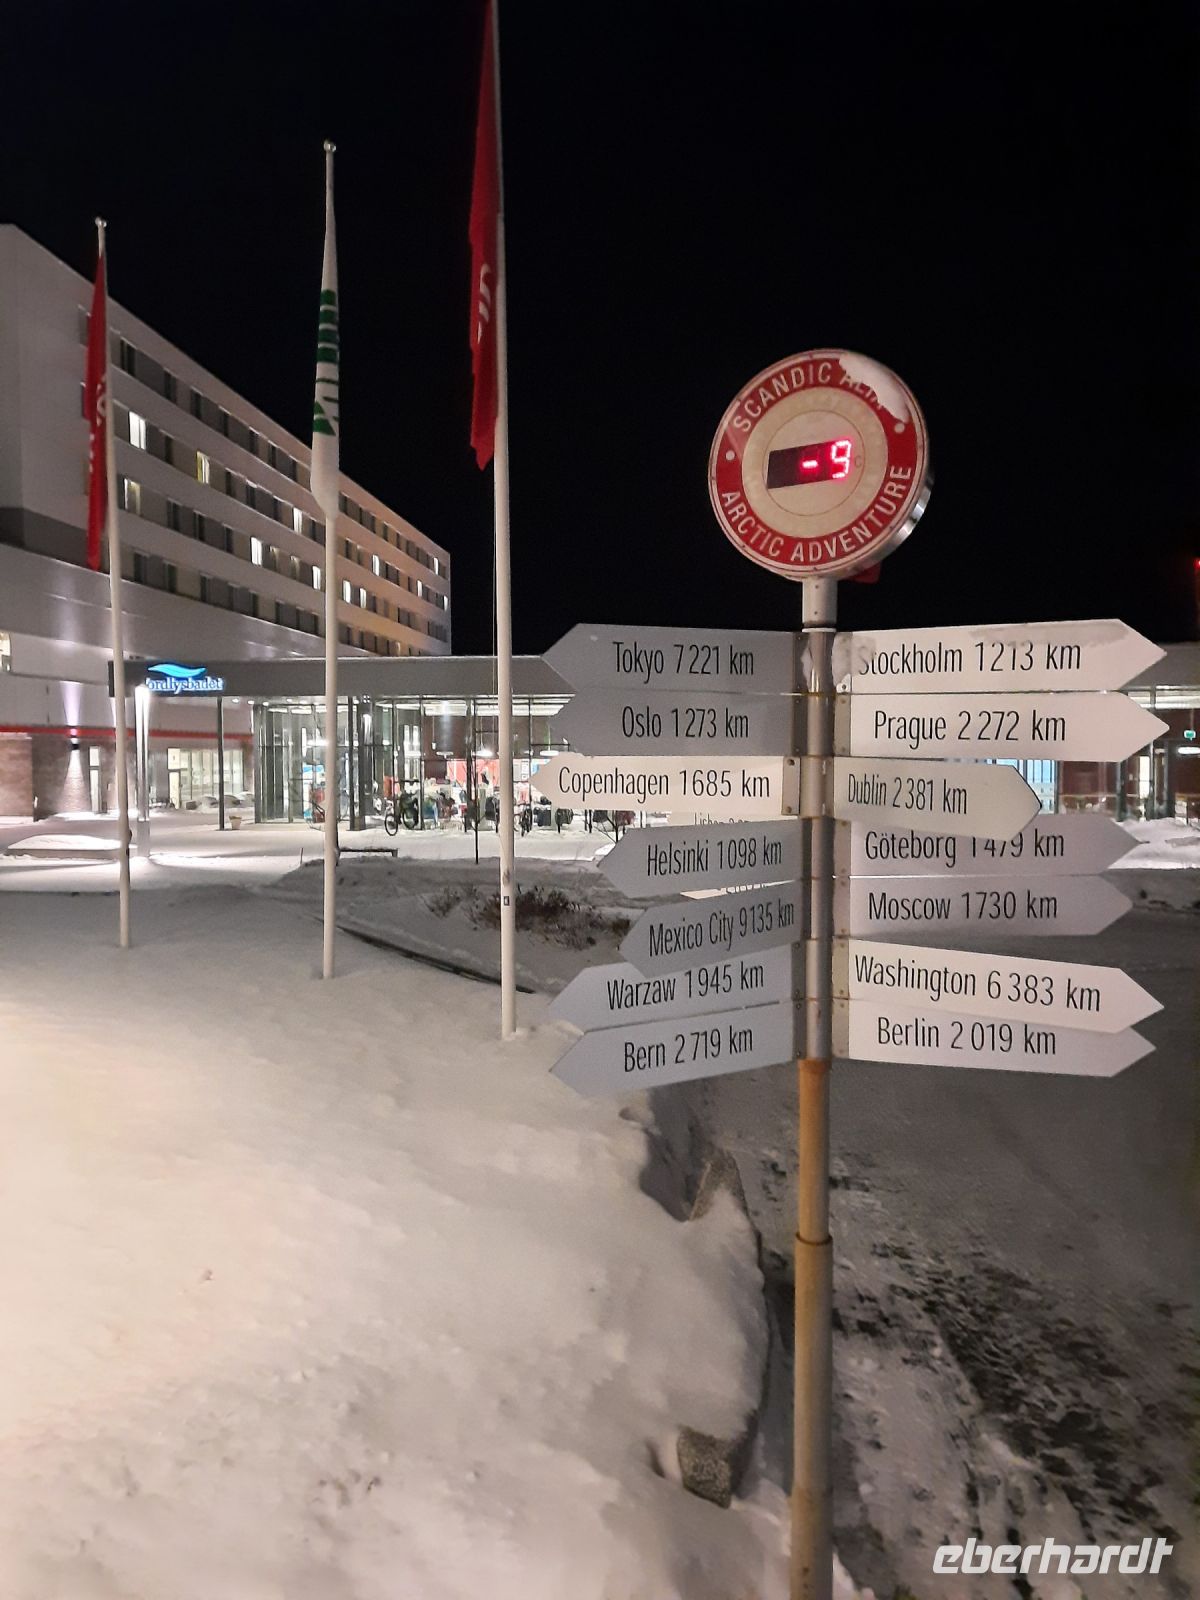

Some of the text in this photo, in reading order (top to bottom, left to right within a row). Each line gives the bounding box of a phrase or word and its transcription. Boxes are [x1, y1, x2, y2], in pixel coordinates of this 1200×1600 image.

[733, 361, 832, 433] SCANDIC
[721, 465, 912, 563] ARCTIC ADVENTURE
[612, 641, 754, 685] Tokyo 7221 km
[975, 641, 1034, 672] 1213
[1046, 643, 1081, 670] km
[622, 705, 749, 738] Oslo 1273 km
[874, 709, 1066, 750] Prague 2272 km
[559, 766, 770, 804] Copenhagen 1685 km
[848, 773, 967, 815] Dublin 2381 km
[647, 835, 782, 877] Helsinki 1098 km
[865, 829, 956, 869] Göteborg
[1034, 828, 1064, 857] km
[869, 889, 1057, 921] Moscow 1730 km
[649, 898, 794, 957] Mexico City 9135 km
[607, 961, 764, 1011] Warzaw 1945 km
[855, 954, 1100, 1012] Washington 6383 km
[624, 1025, 753, 1073] Bern 2719 km
[878, 1016, 1056, 1055] Berlin 2019 km
